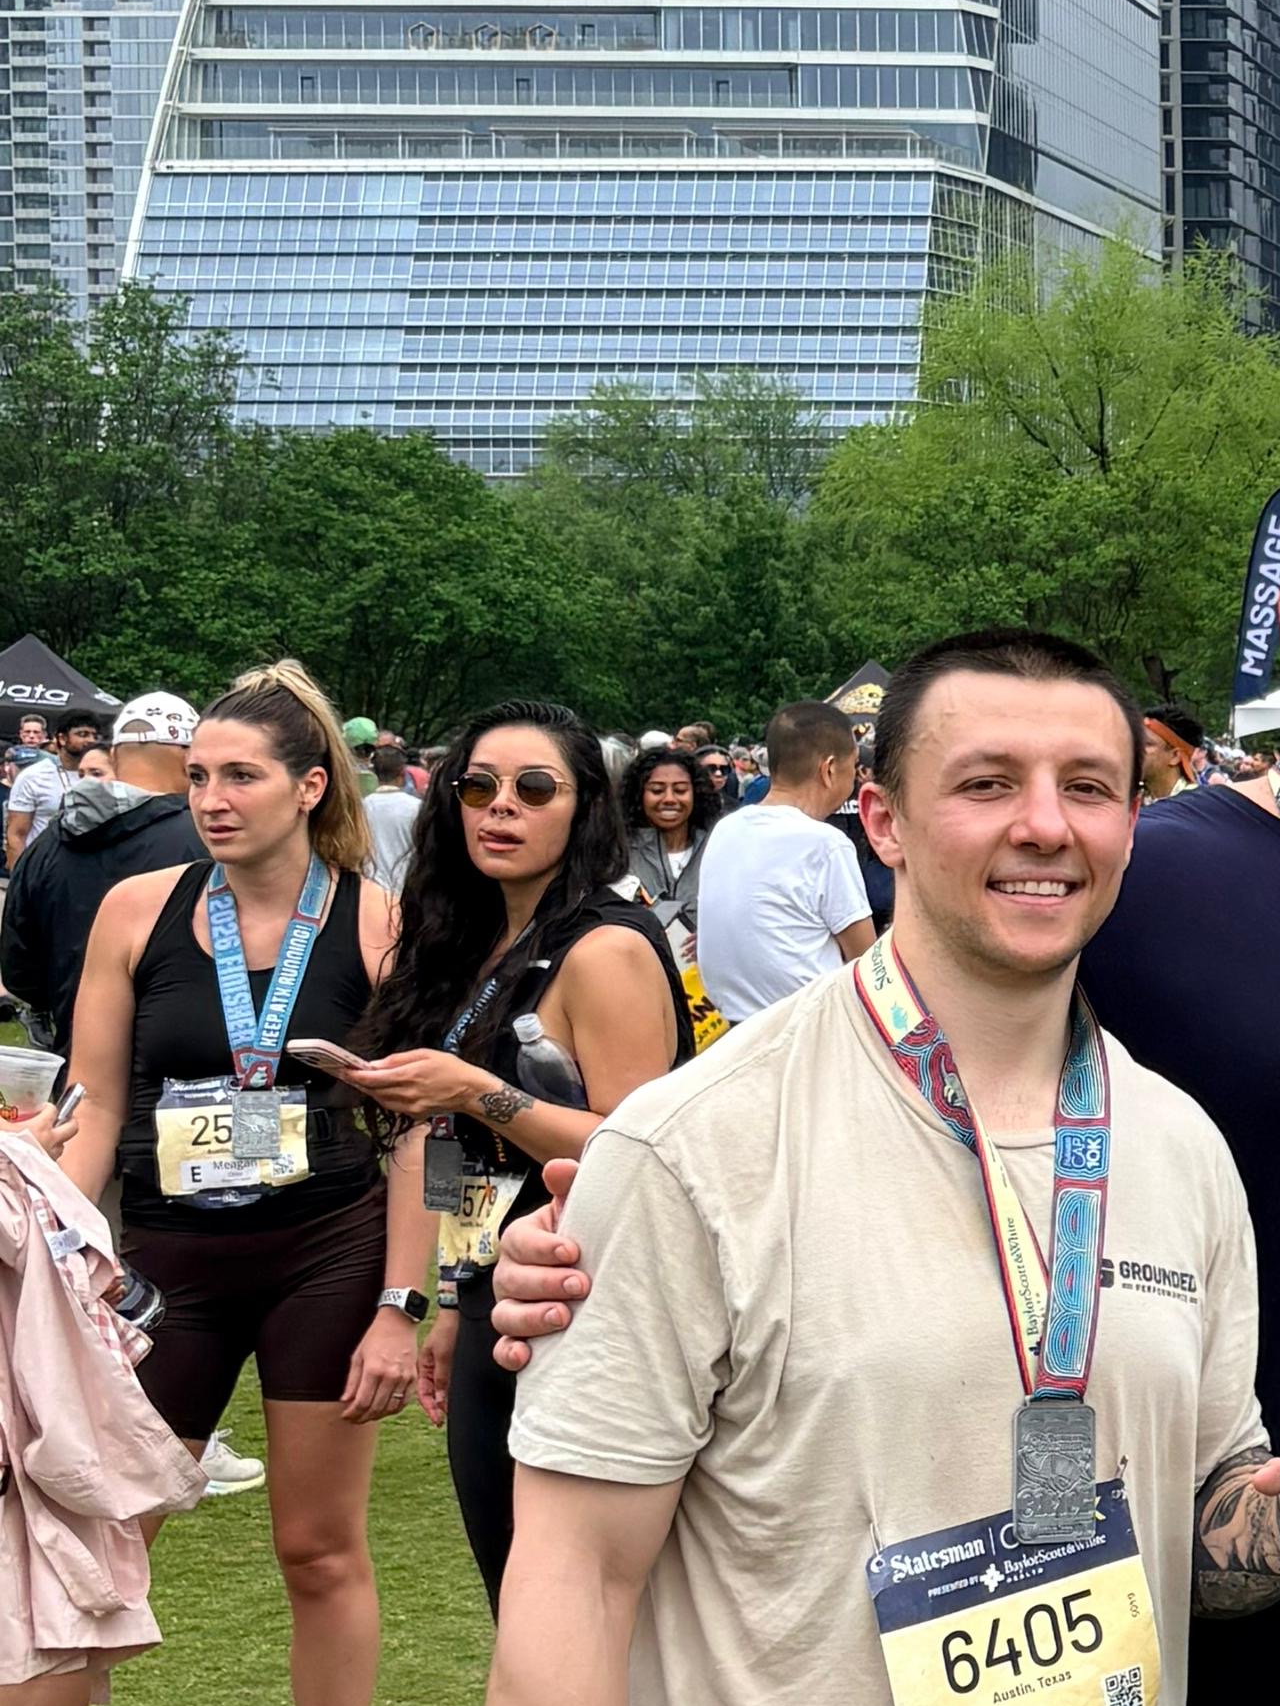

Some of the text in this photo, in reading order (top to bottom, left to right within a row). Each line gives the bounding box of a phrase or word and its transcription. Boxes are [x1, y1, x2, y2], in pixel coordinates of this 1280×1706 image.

[257, 923, 314, 1048] KEEP ATX RUNNING!
[190, 1166, 202, 1183] E
[213, 1160, 257, 1172] Meagan
[1119, 1260, 1198, 1293] GROUNDED
[890, 1534, 986, 1584] Statesman
[941, 1588, 1104, 1695] 6405
[993, 1670, 1072, 1704] Austin, Texas
